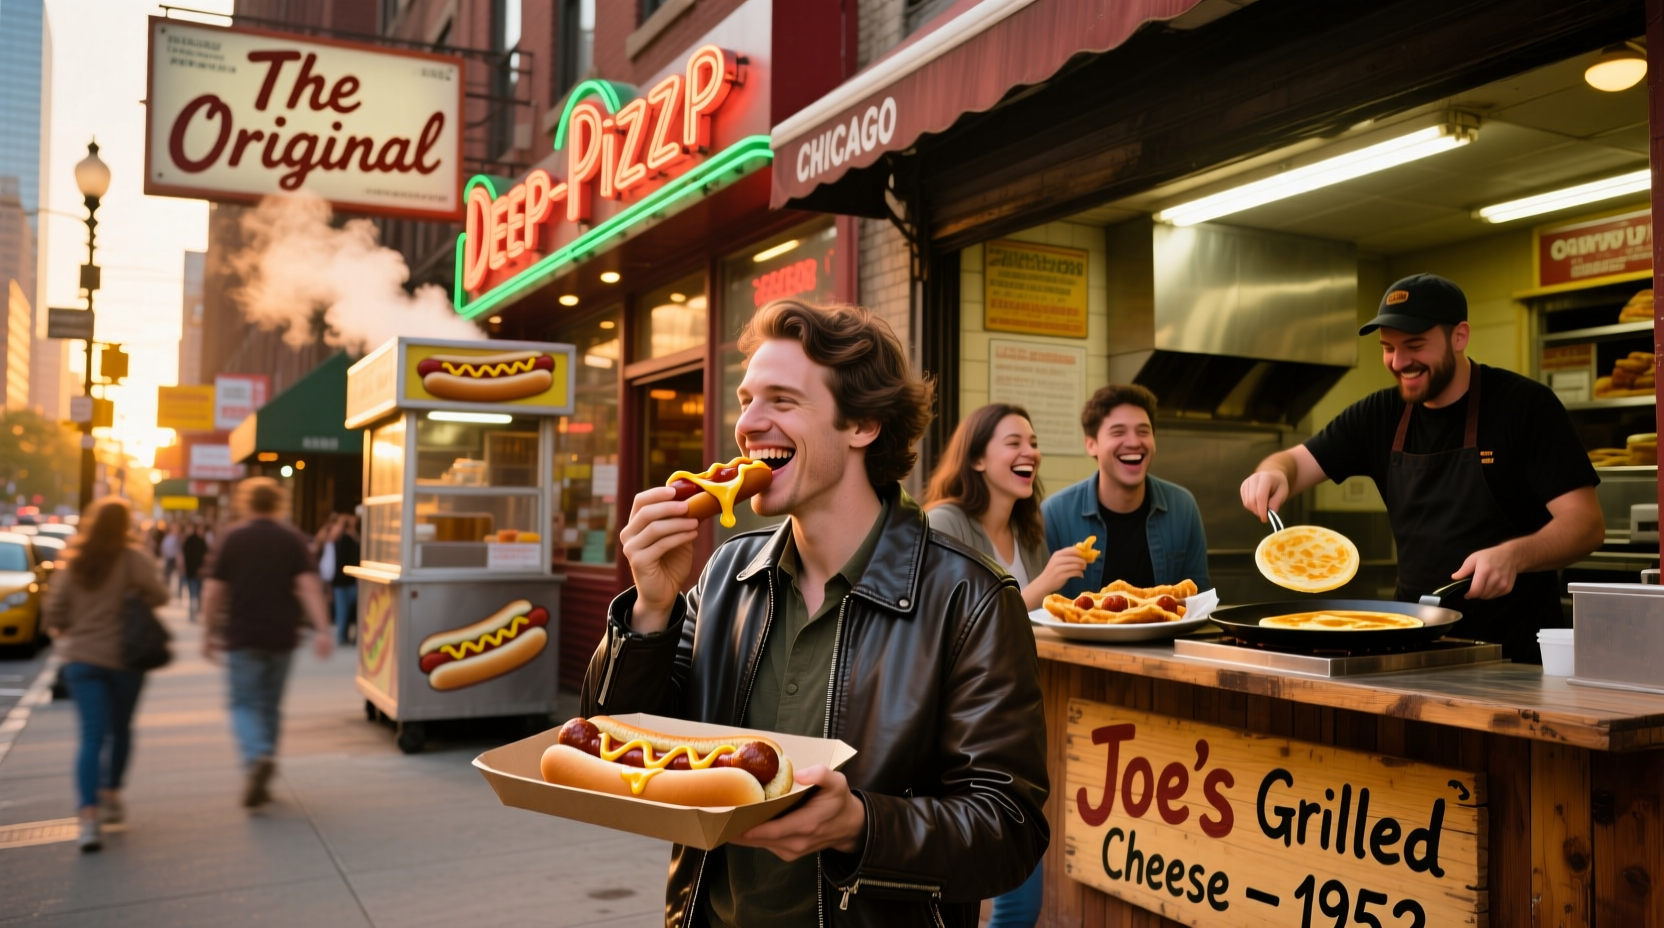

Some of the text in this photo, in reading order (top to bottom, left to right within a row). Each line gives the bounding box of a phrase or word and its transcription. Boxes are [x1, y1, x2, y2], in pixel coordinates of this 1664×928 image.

[247, 50, 362, 114] The
[168, 93, 445, 191] Original
[796, 96, 897, 183] CHICAGO
[1076, 723, 1446, 878] Joe’s Grilled
[1102, 827, 1230, 912] Cheese
